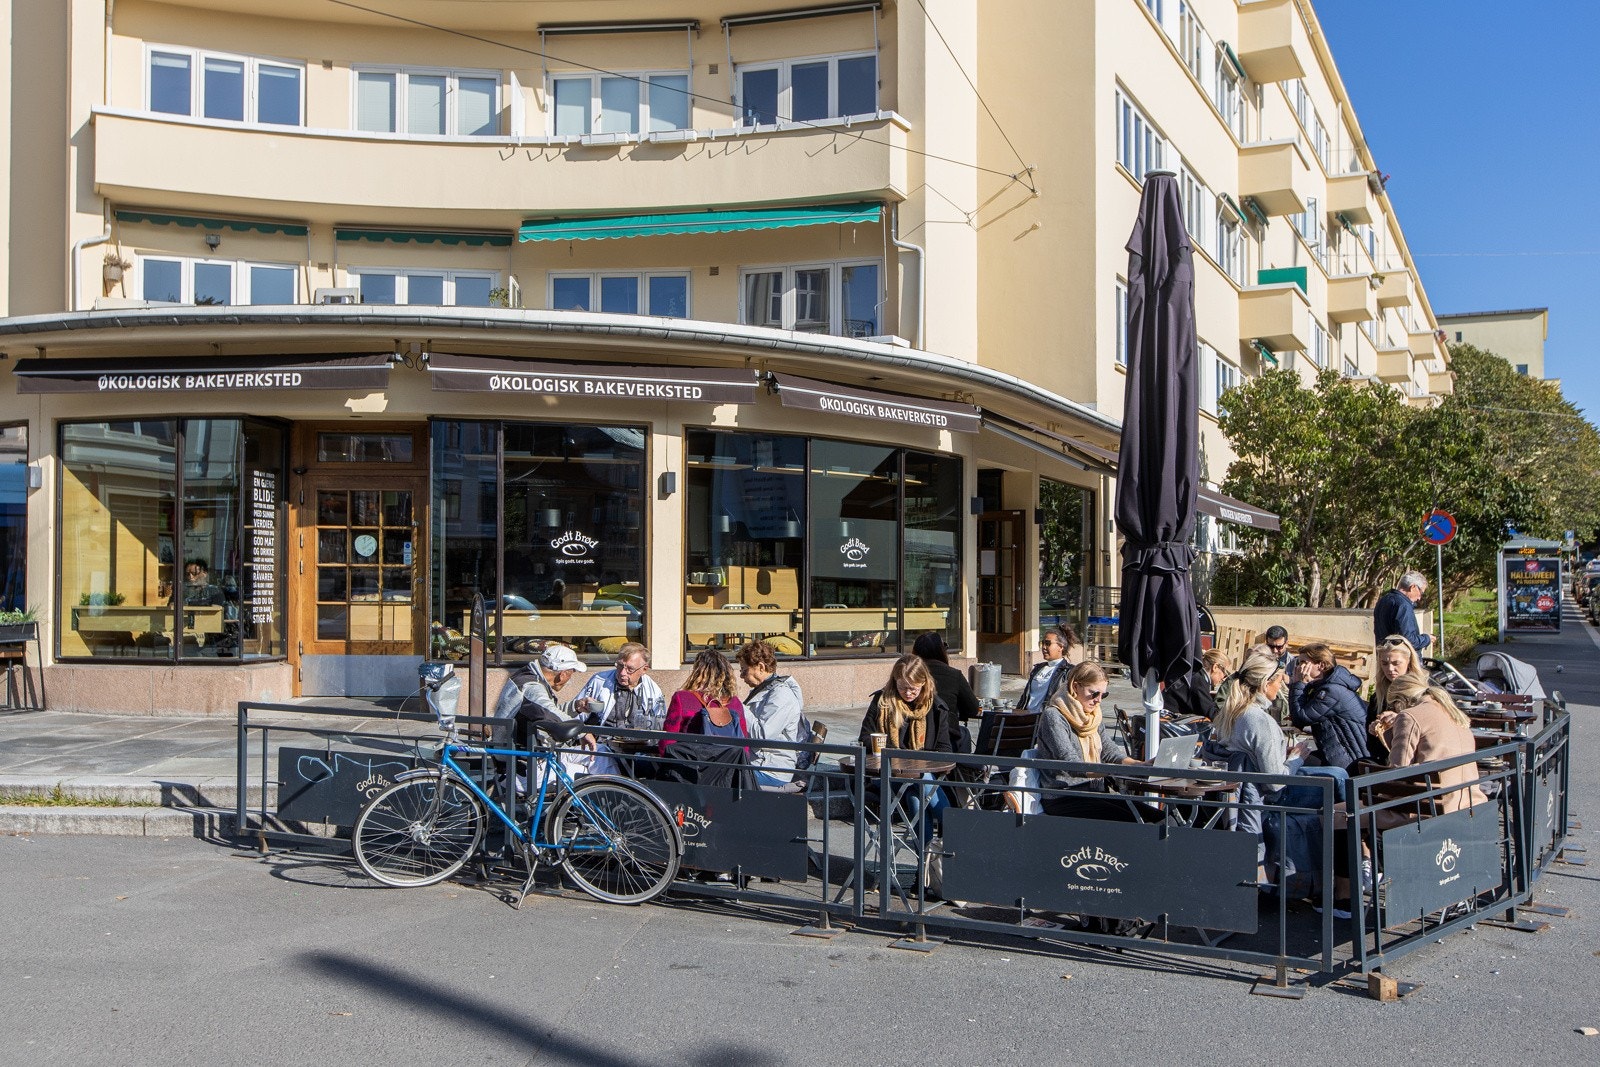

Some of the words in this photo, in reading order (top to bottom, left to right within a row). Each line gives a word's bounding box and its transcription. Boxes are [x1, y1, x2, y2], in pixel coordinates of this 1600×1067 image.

[98, 374, 180, 390] ØKOLOGISK
[185, 372, 302, 389] BAKEVERKSTED
[489, 374, 579, 393] ØKOLOGISK
[584, 380, 702, 399] BAKEVERKSTED
[820, 397, 875, 416] ØKOLOGISK
[878, 407, 946, 426] BAKEVERKSTED
[254, 488, 274, 502] BLIDE
[265, 538, 274, 546] MAT
[551, 531, 572, 548] Godt
[575, 531, 599, 548] Brød
[841, 538, 854, 553] Godt
[357, 774, 376, 791] Godt
[687, 807, 712, 828] Brød
[1061, 846, 1092, 868] Godt
